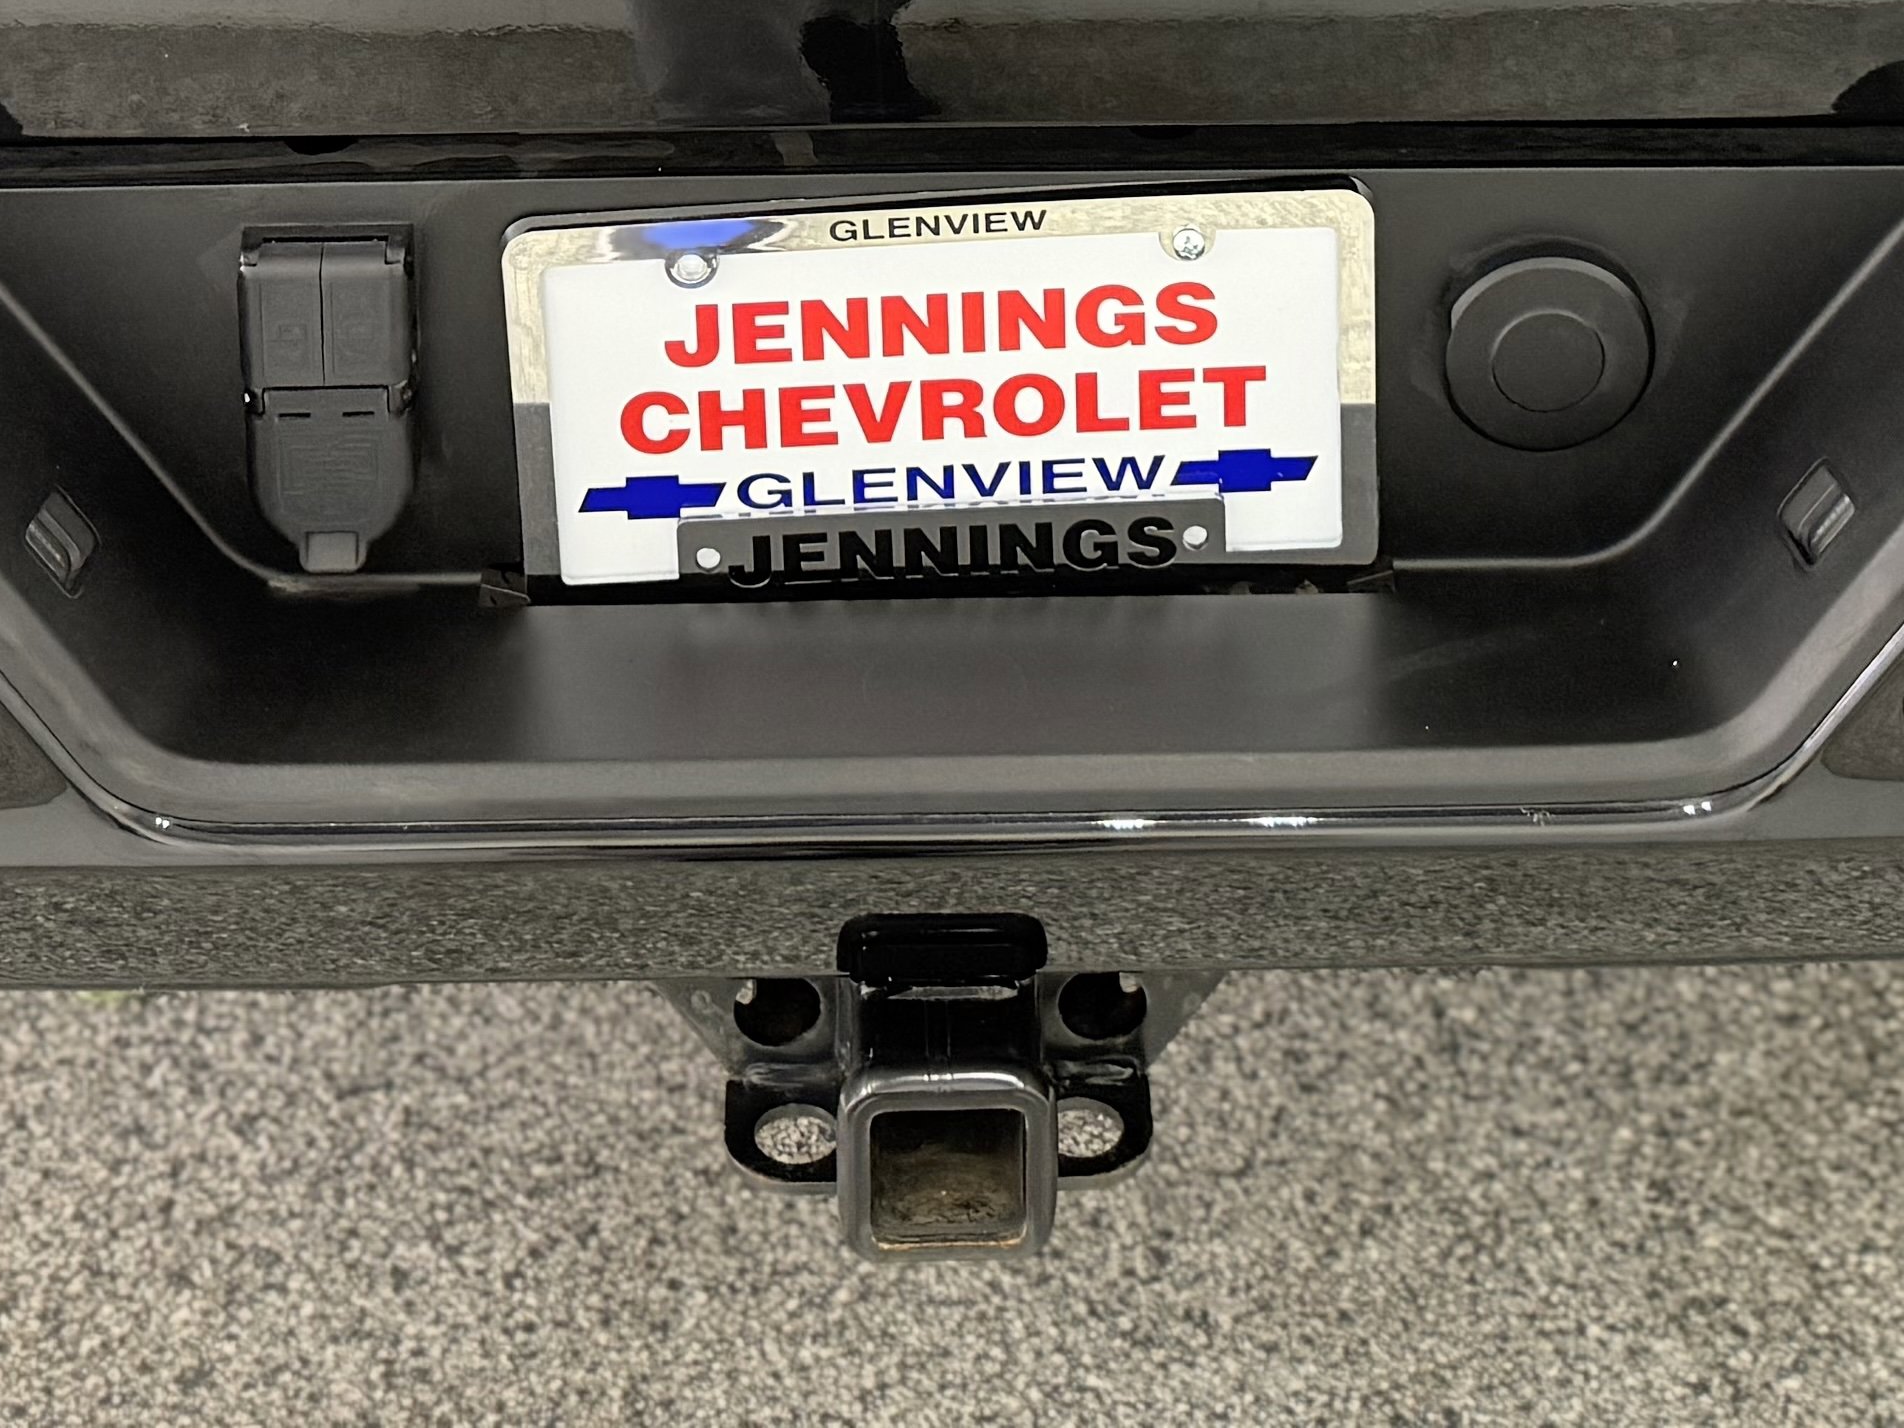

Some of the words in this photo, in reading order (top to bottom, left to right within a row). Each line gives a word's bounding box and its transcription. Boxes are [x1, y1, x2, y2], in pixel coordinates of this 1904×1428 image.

[830, 209, 1047, 242] GLENVIEW
[665, 282, 1219, 367] JENNINGS
[620, 366, 1266, 454] CHEVROLET
[736, 455, 1166, 509] GLENVIEW
[728, 516, 1178, 588] JENNINGS
